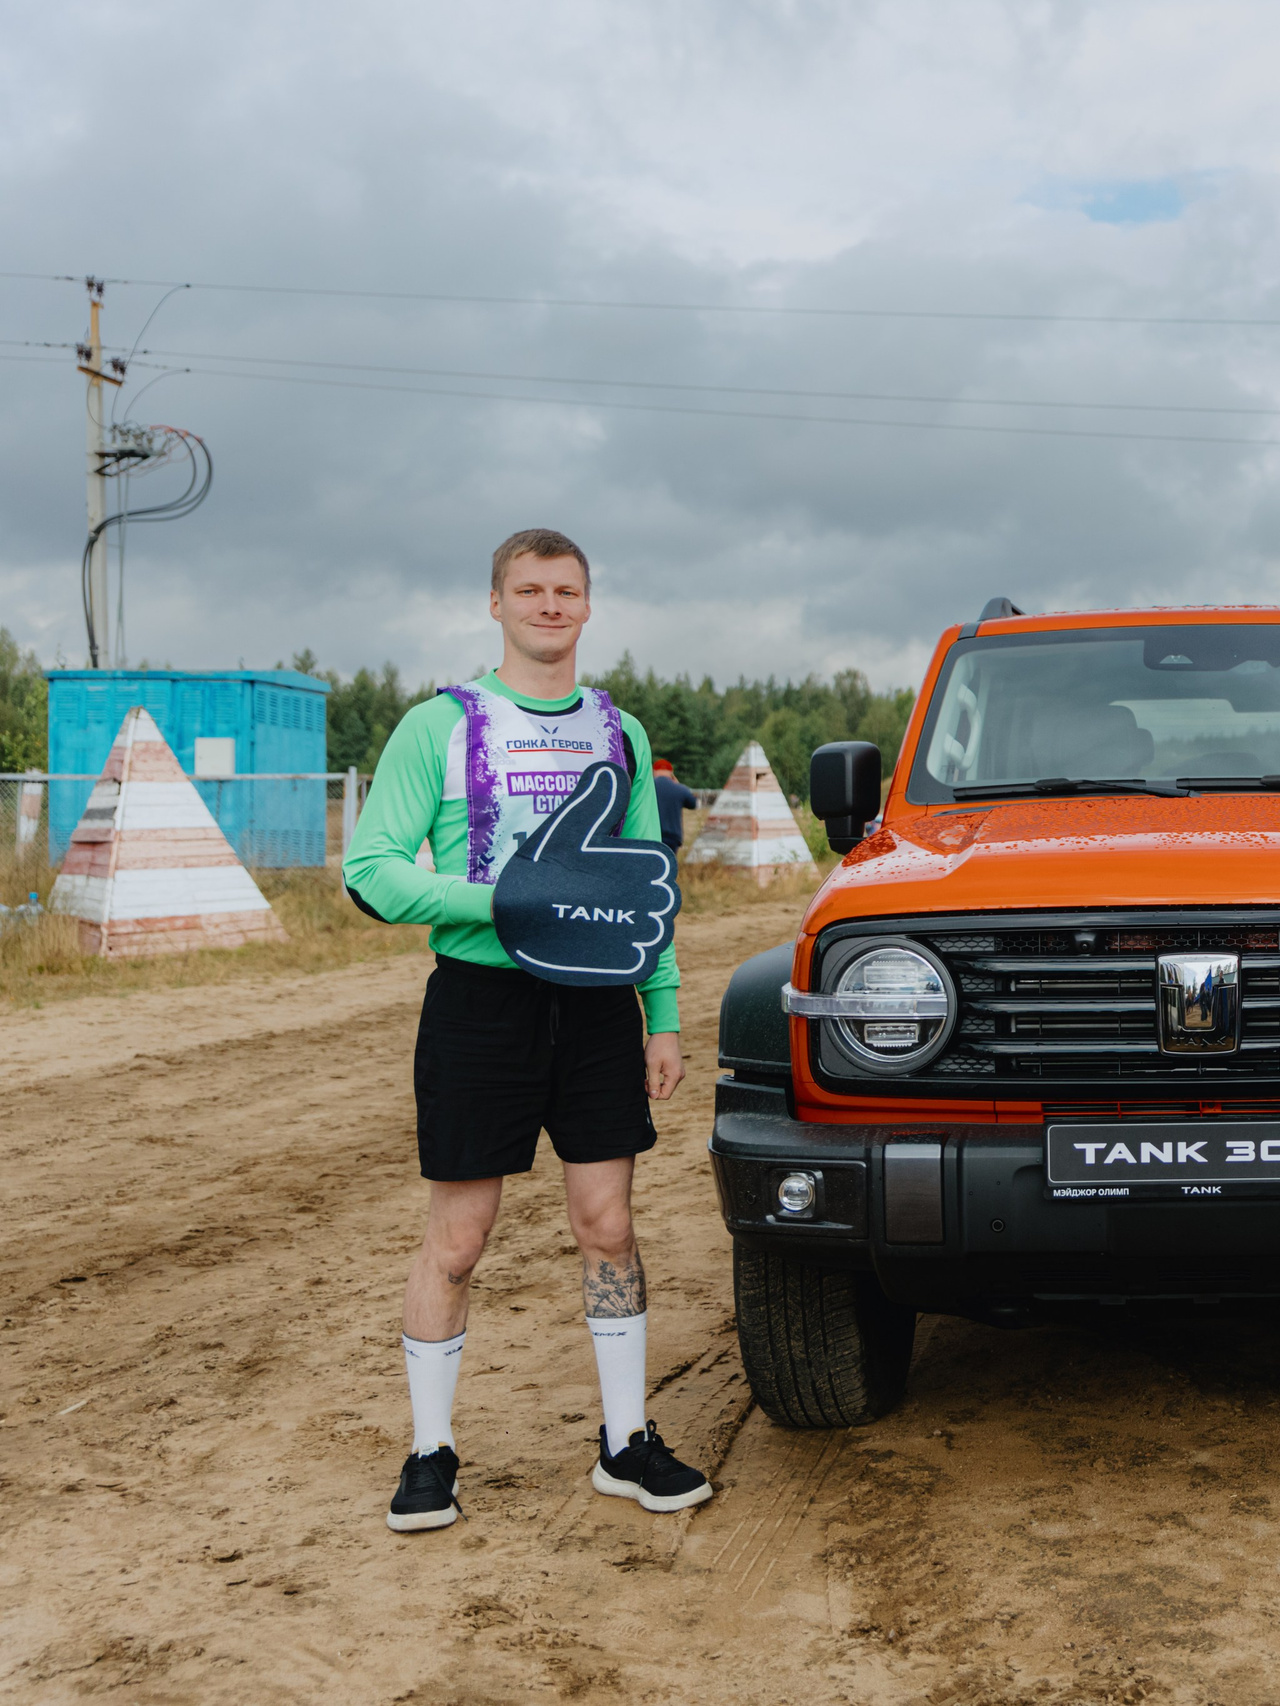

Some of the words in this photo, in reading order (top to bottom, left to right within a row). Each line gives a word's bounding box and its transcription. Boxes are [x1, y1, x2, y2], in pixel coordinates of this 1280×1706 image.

[506, 739, 548, 749] ГОНКА
[551, 739, 593, 750] ГЕРОЕВ
[510, 773, 580, 793] МАССОВ
[536, 794, 567, 813] СТА
[551, 903, 636, 924] TANK
[1073, 1141, 1208, 1165] TANK
[1053, 1187, 1097, 1198] МЭЙДЖОР
[1098, 1187, 1130, 1196] ОЛИМП
[1181, 1186, 1222, 1194] TANK
